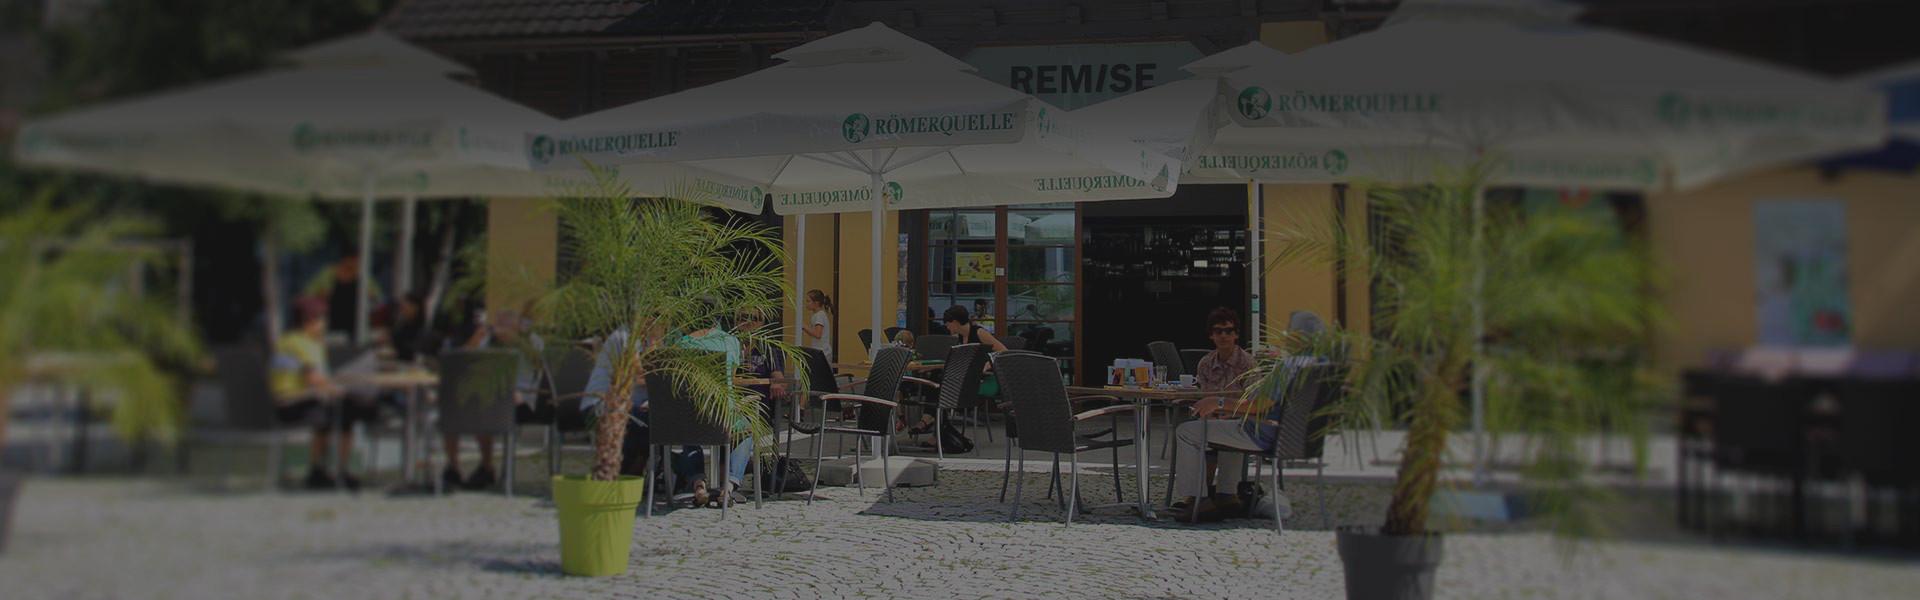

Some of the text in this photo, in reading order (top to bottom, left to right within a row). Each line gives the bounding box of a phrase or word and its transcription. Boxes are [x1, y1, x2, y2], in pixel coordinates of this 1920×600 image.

[1278, 90, 1442, 114] RÖMERQUELLE
[875, 112, 1014, 136] RÖMERQUELLE
[558, 130, 678, 156] RÖMERQUELLE
